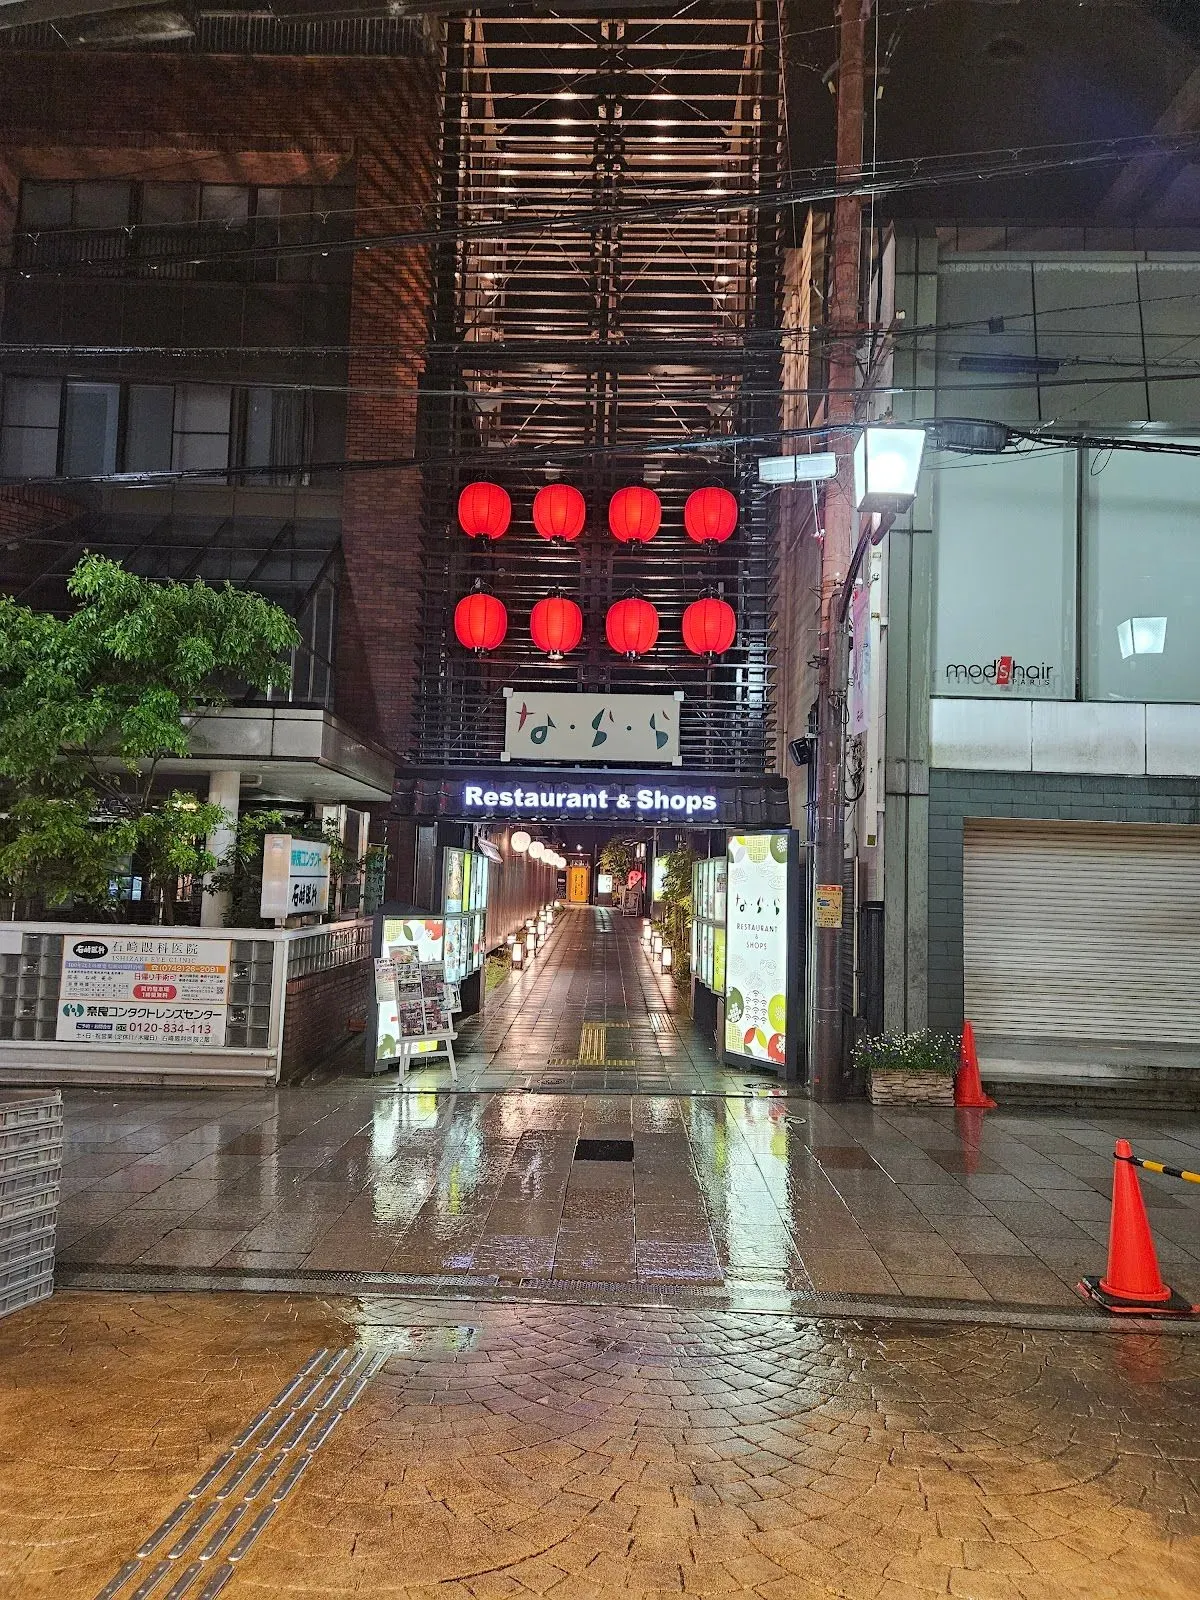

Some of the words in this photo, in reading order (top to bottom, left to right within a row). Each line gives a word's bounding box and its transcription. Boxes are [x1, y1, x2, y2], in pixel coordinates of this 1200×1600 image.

[1012, 660, 1054, 679] hair
[464, 786, 608, 808] Restaurant
[616, 792, 631, 808] &
[637, 789, 717, 814] Shops
[736, 922, 778, 933] RESTAURANT
[746, 941, 767, 950] SHOPS
[134, 973, 176, 982] 日帰り手術可
[86, 1006, 222, 1020] 奈良コンタクトレンズセンター
[129, 1022, 212, 1035] 0120-834-113
